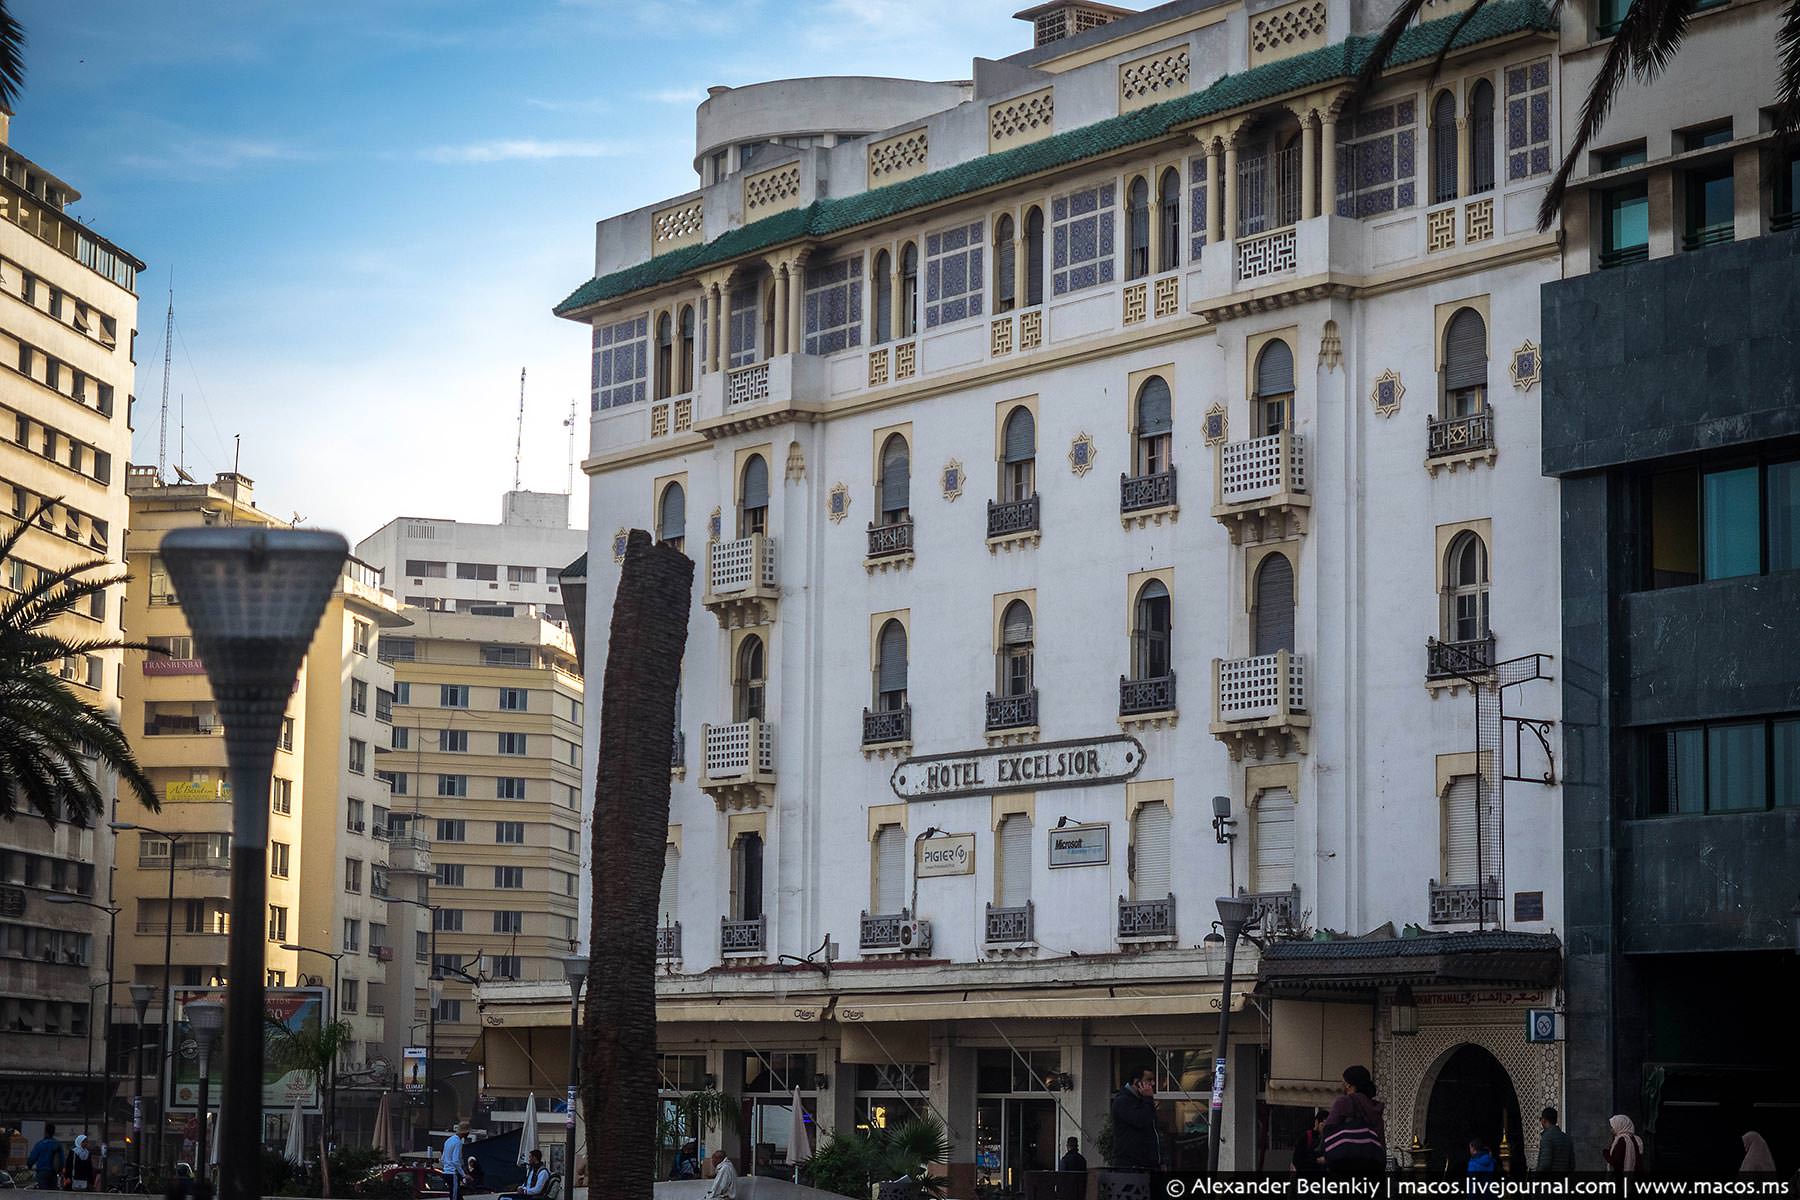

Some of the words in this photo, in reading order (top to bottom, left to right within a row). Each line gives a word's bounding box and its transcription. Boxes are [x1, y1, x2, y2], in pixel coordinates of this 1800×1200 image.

[927, 761, 984, 789] HOTEL
[998, 750, 1100, 783] EXCELSIOR
[1055, 838, 1082, 850] Microsoft
[924, 850, 954, 863] PIGIER
